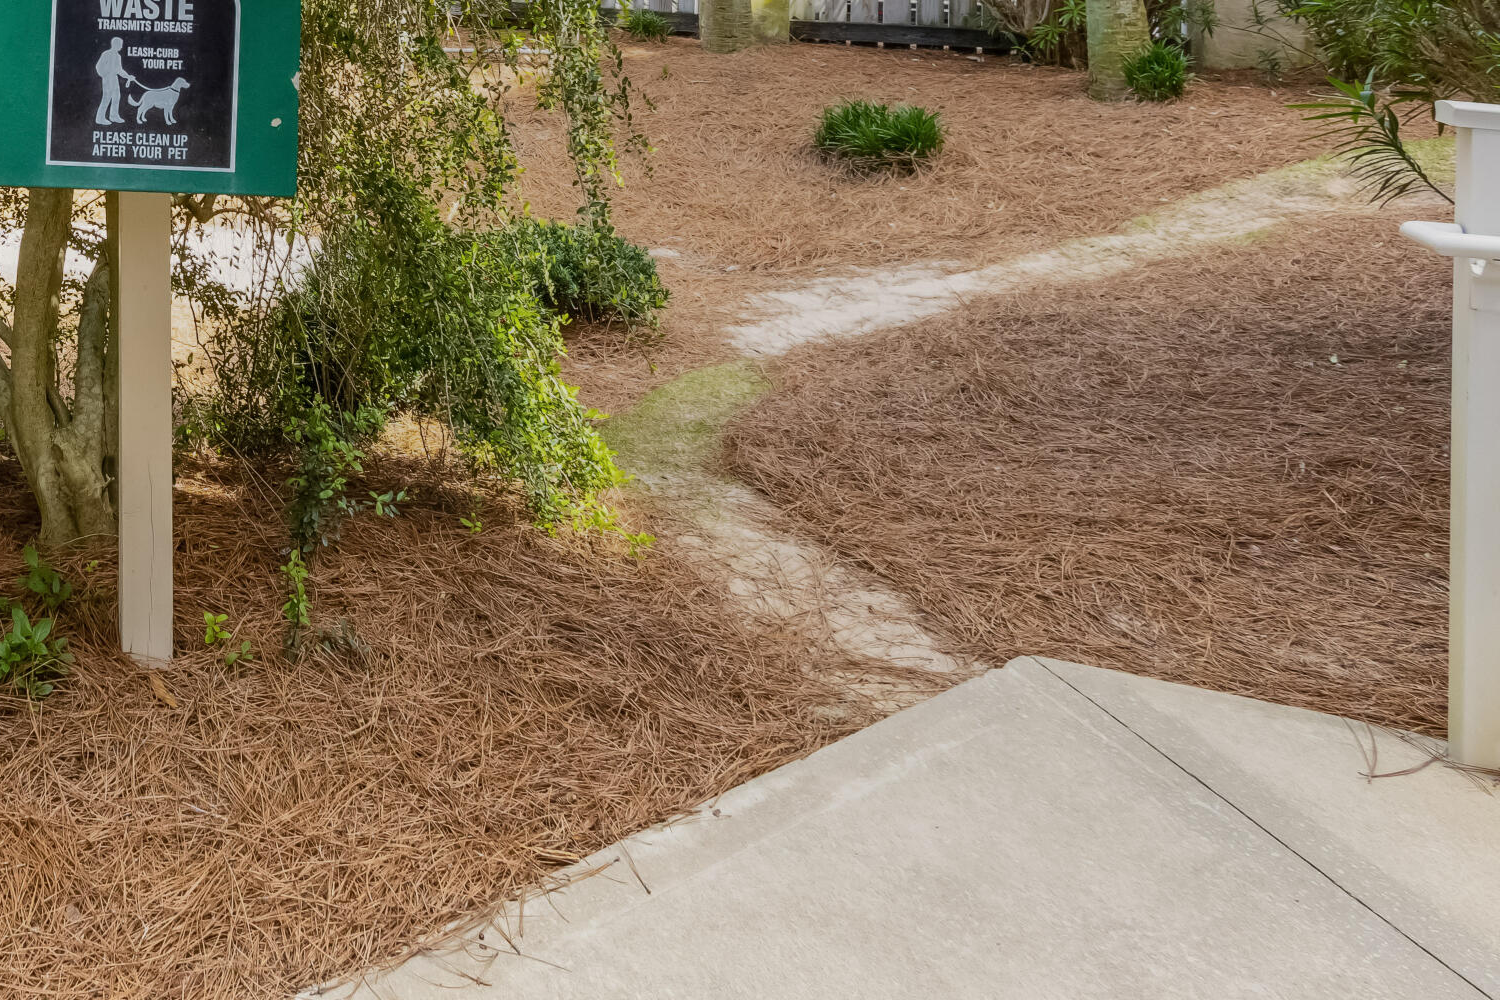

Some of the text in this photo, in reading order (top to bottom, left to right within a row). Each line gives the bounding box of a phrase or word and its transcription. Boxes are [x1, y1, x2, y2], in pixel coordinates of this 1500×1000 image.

[98, 19, 193, 33] TRANSMITS DISEASE
[127, 47, 179, 58] LEASH-CURB
[142, 59, 183, 70] YOUR PET
[93, 131, 188, 146] PLEASE CLEAN UP
[92, 145, 188, 159] AFTER YOUR PET
